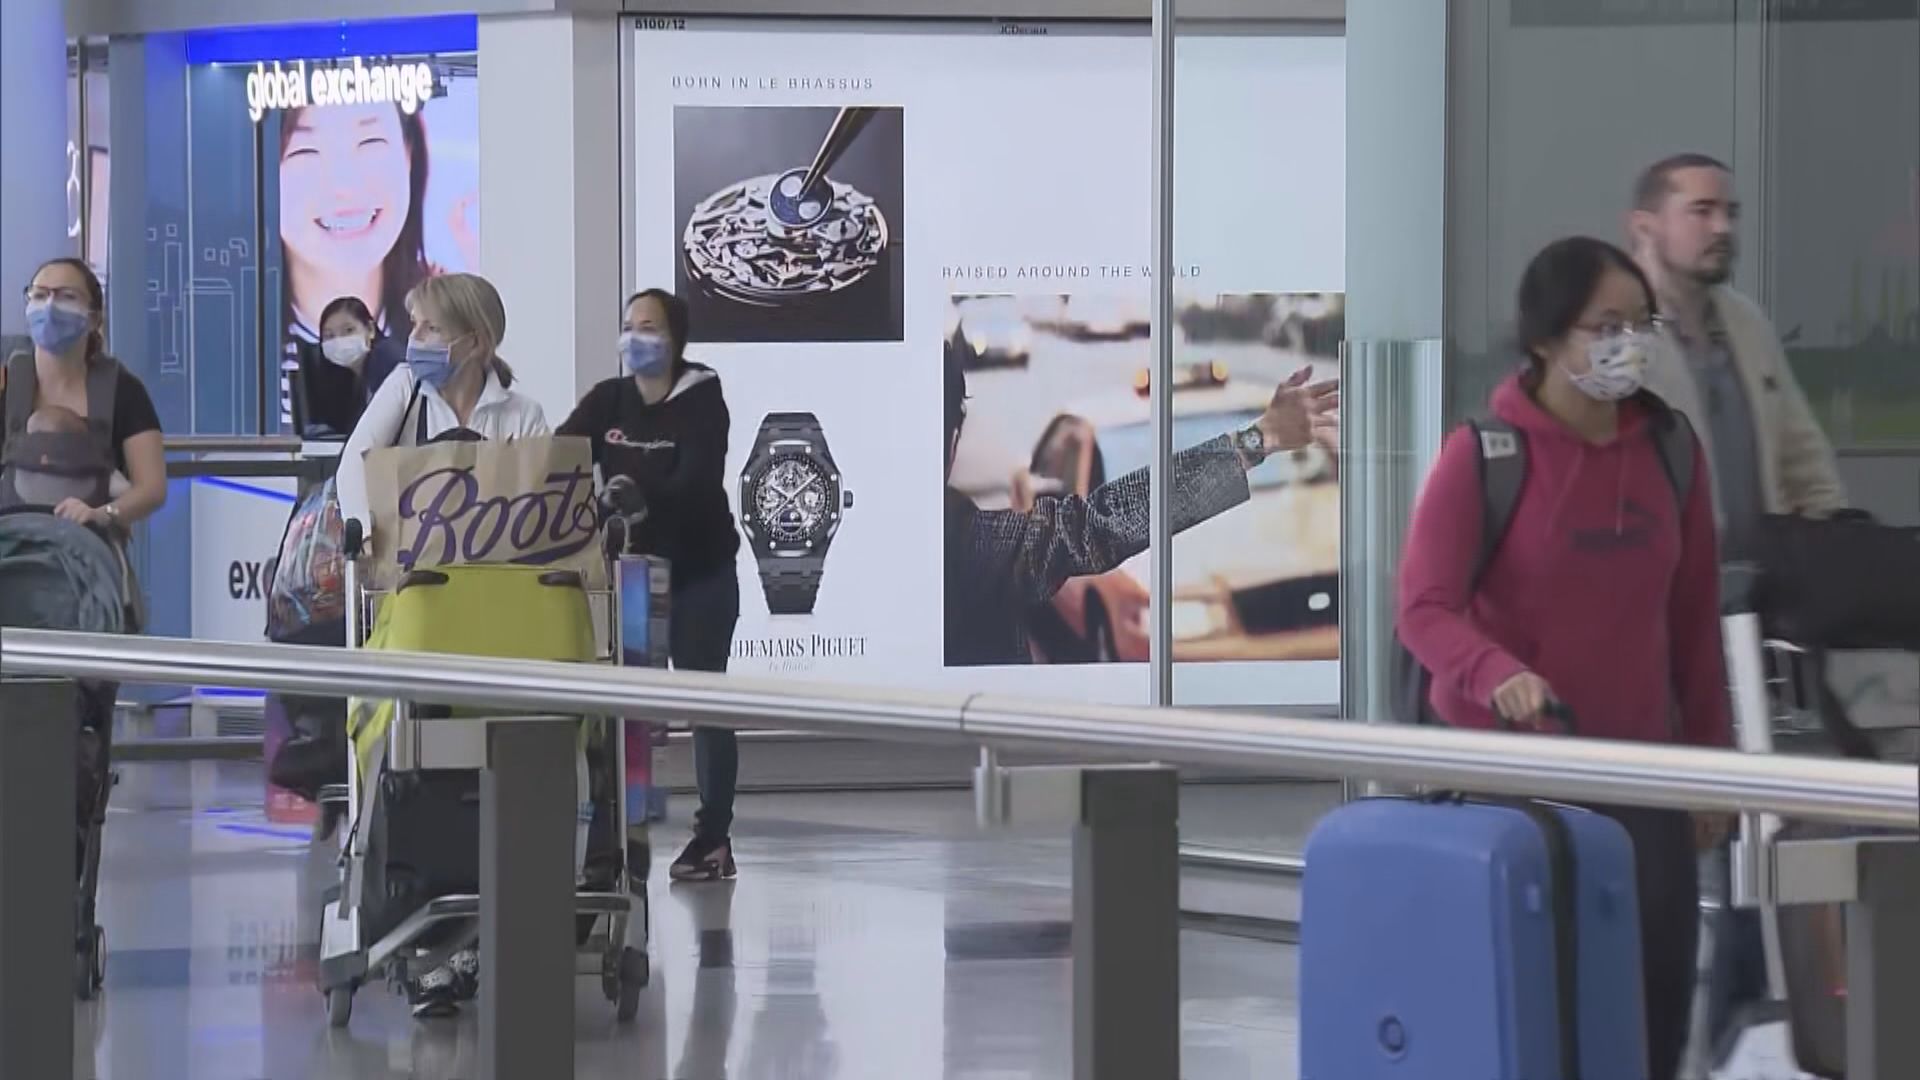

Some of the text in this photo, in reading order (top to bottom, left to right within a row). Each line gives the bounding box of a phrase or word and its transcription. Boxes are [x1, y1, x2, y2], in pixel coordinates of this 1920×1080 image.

[246, 55, 432, 122] global exchange
[671, 76, 873, 90] BORN IN LE BRASSUS
[941, 265, 1008, 279] RAISED
[1016, 265, 1091, 278] AROUND
[1100, 265, 1133, 278] THE
[397, 464, 599, 571] Roots
[811, 633, 868, 657] PIGUET
